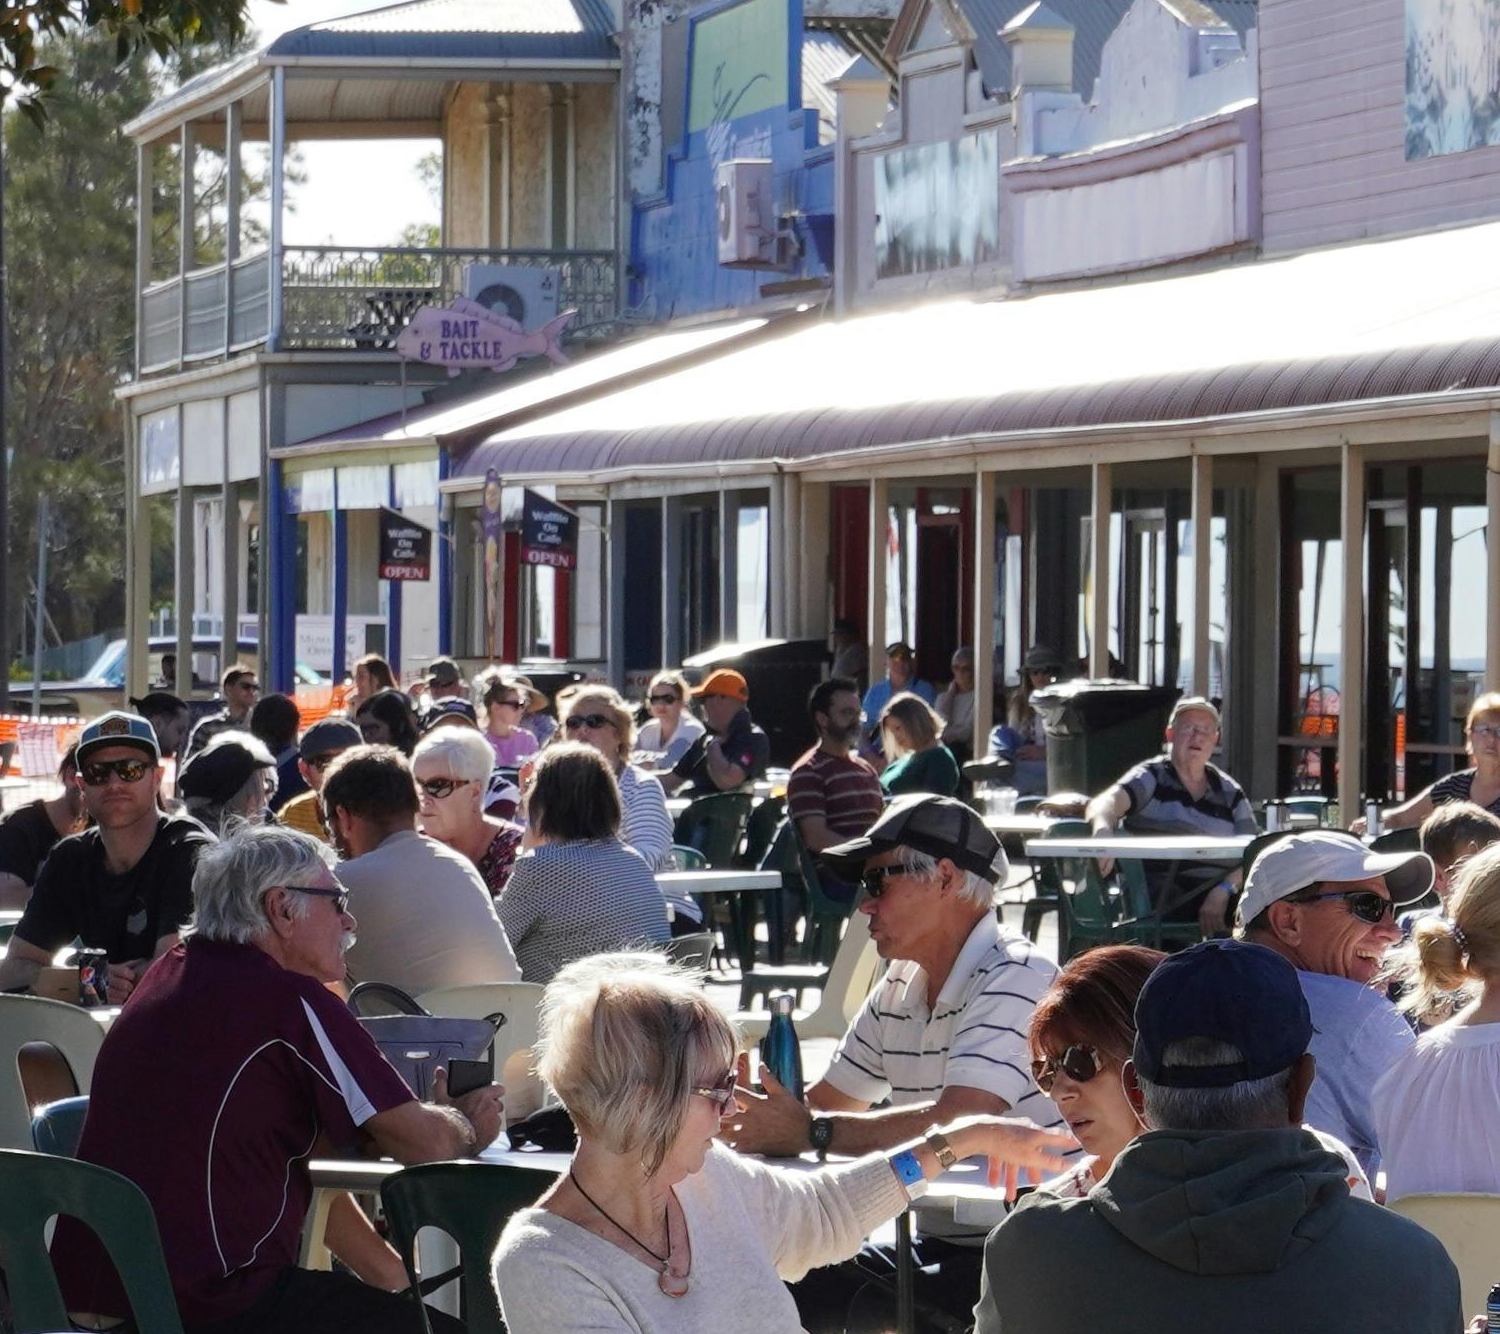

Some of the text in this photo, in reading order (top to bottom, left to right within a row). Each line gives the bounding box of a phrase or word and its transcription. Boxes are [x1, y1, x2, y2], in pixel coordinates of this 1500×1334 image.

[441, 320, 479, 339] BAIT
[420, 342, 503, 360] & TACKLE
[528, 551, 569, 567] OPEN
[385, 567, 424, 578] OPEN
